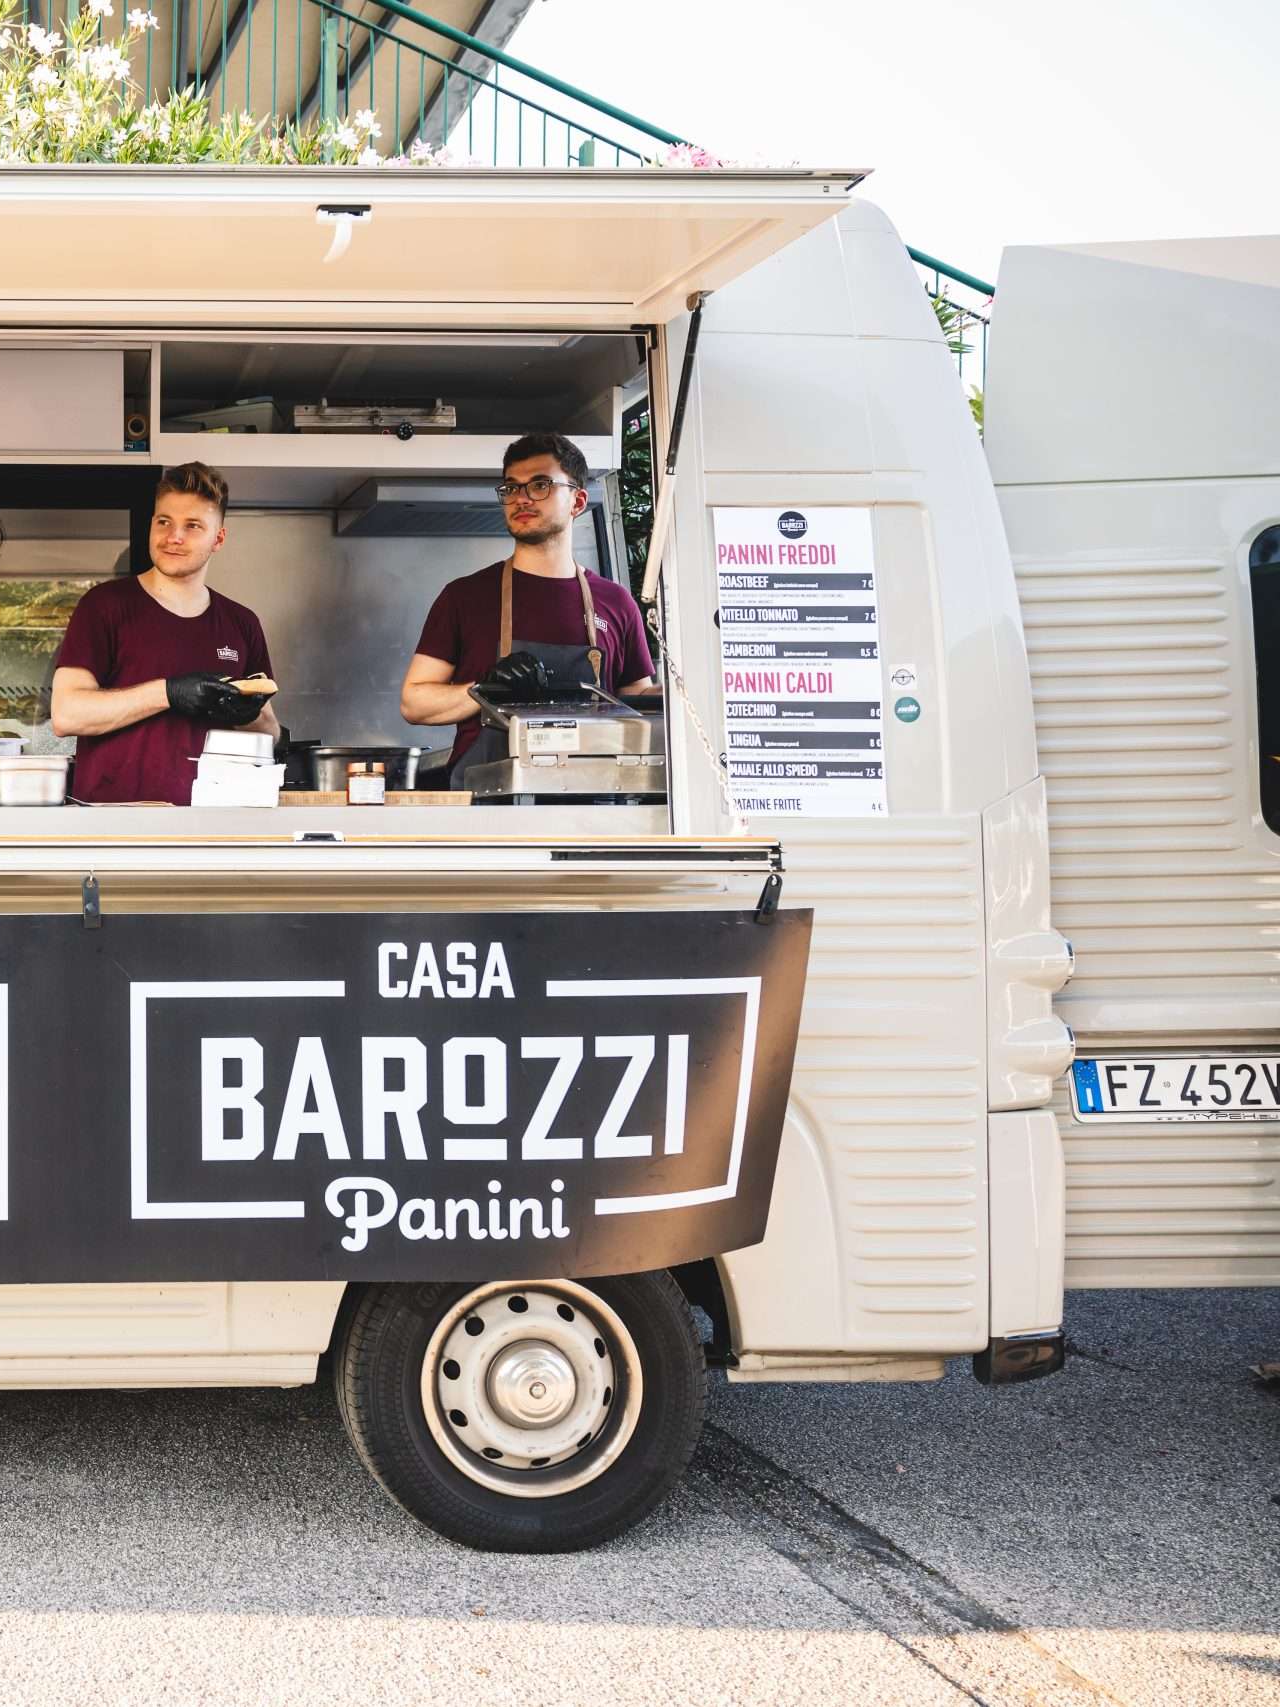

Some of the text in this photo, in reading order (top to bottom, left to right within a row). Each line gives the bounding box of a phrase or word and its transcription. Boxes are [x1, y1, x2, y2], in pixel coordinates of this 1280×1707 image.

[718, 544, 836, 565] PANINI FREDDI
[720, 575, 768, 588] ROASTBEEF
[720, 608, 756, 621] VITELLO
[756, 608, 798, 621] TONNATO
[723, 644, 776, 657] GAMBERONI
[724, 672, 833, 694] PANINI CALDI
[726, 704, 776, 716] COTECHINO
[729, 734, 762, 746] LINGUA
[763, 764, 784, 776] ALLO
[786, 764, 818, 776] SPIEDO
[774, 798, 802, 810] FRITTE
[378, 942, 516, 999] CASA
[1105, 1064, 1161, 1107] FZ
[200, 1034, 689, 1161] BAROZZI
[324, 1176, 571, 1252] Panini
